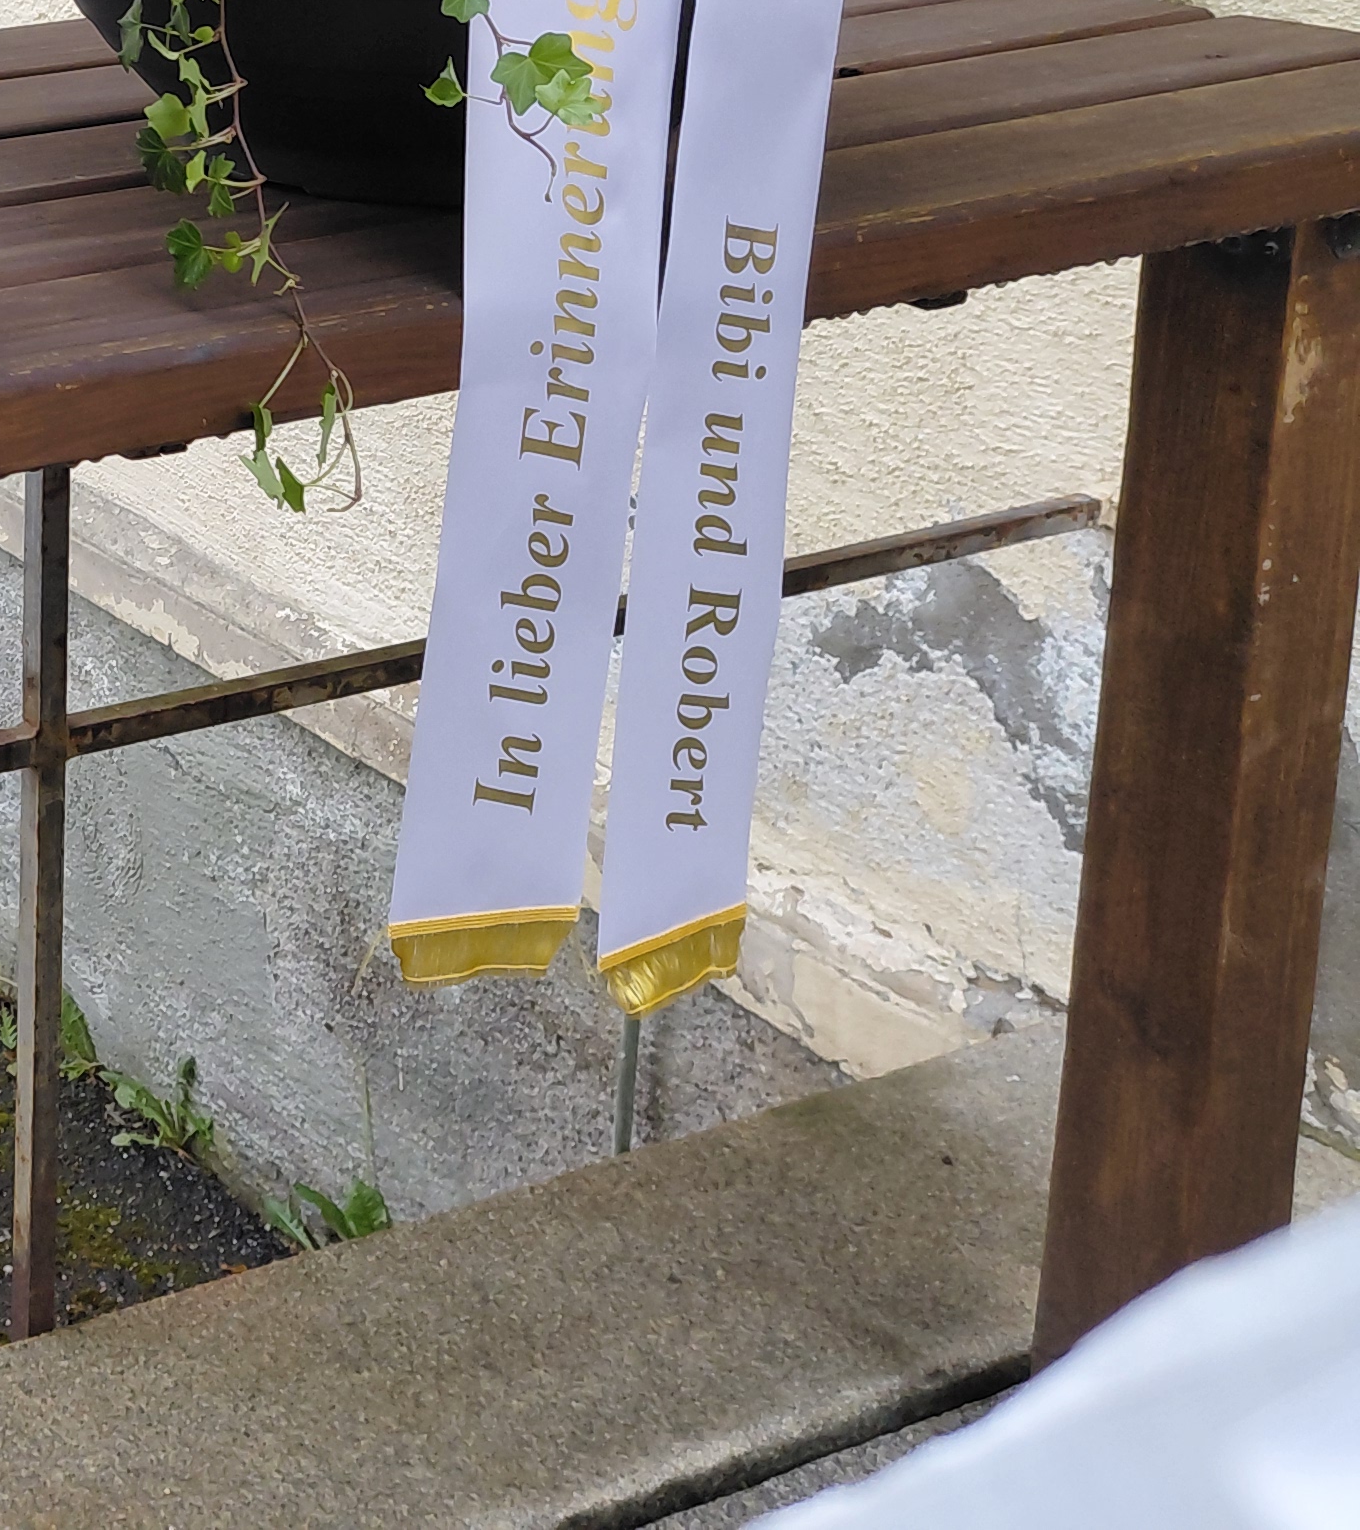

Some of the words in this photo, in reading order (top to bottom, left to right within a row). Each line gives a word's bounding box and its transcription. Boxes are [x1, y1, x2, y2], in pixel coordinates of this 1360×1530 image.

[711, 214, 780, 382] Bibi
[691, 411, 748, 558] und
[488, 493, 575, 707] lieber
[472, 732, 542, 816] In
[664, 582, 743, 833] Robert
